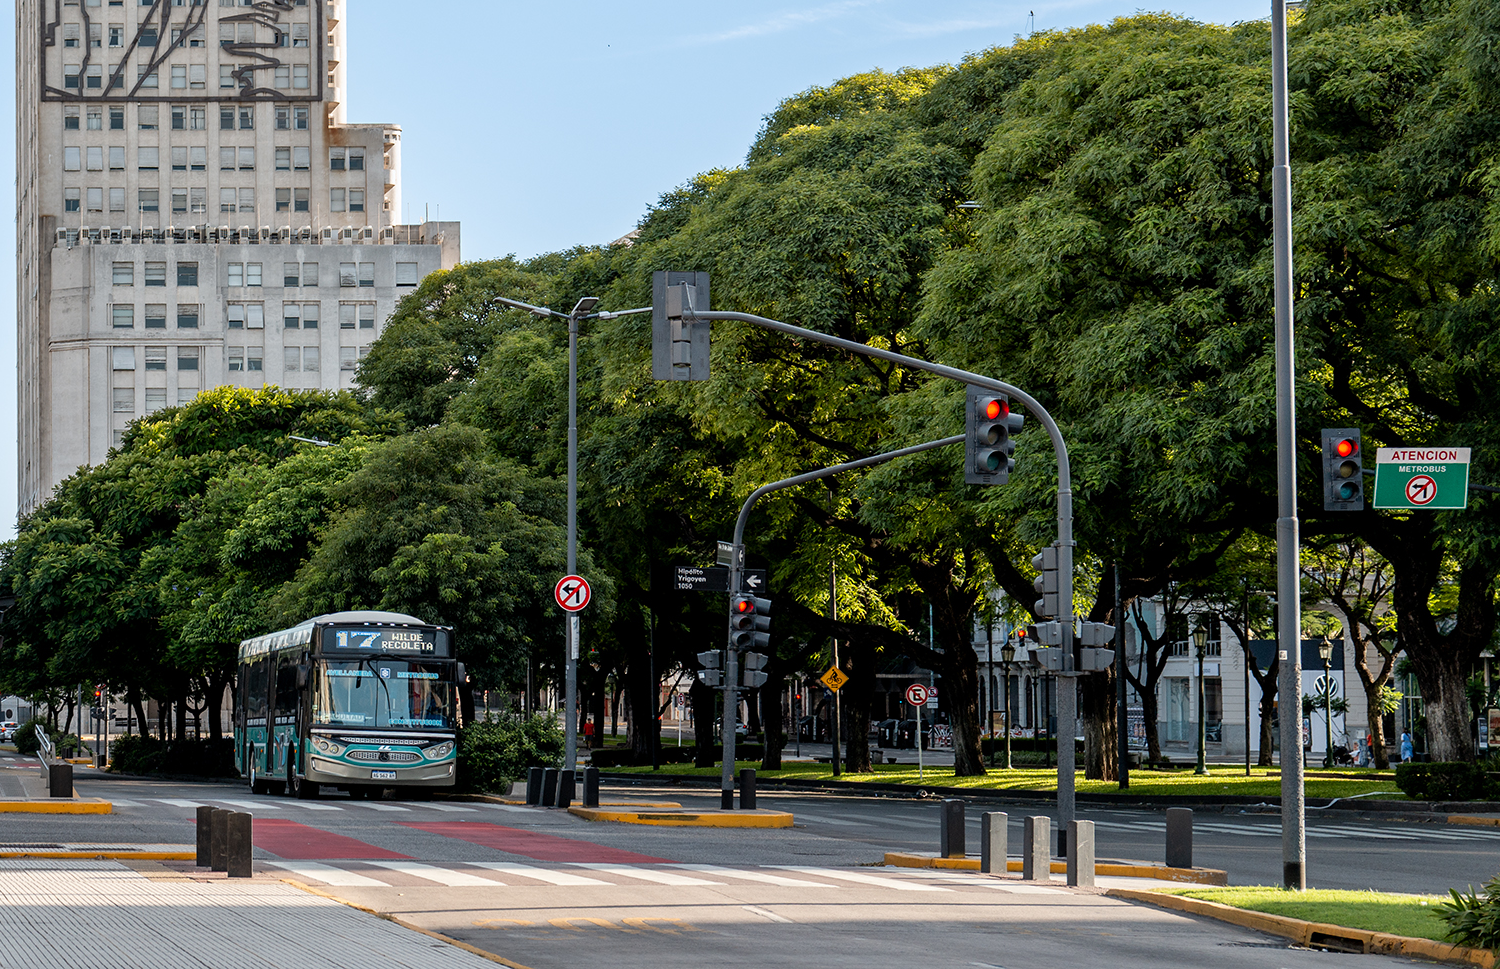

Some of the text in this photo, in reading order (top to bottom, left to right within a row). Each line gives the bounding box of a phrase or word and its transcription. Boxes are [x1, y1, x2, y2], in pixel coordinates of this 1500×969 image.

[1391, 450, 1457, 461] ATENCION
[1398, 465, 1446, 473] METROBUS
[678, 568, 703, 576] Hipólito
[678, 575, 707, 583] Yrigoyen
[335, 631, 381, 648] 17
[391, 633, 424, 642] WILDE
[381, 641, 434, 651] RECOLETA
[326, 669, 373, 678] AVELLANEDA
[396, 671, 439, 680] METROBUS
[388, 718, 443, 727] CONSTITUCION
